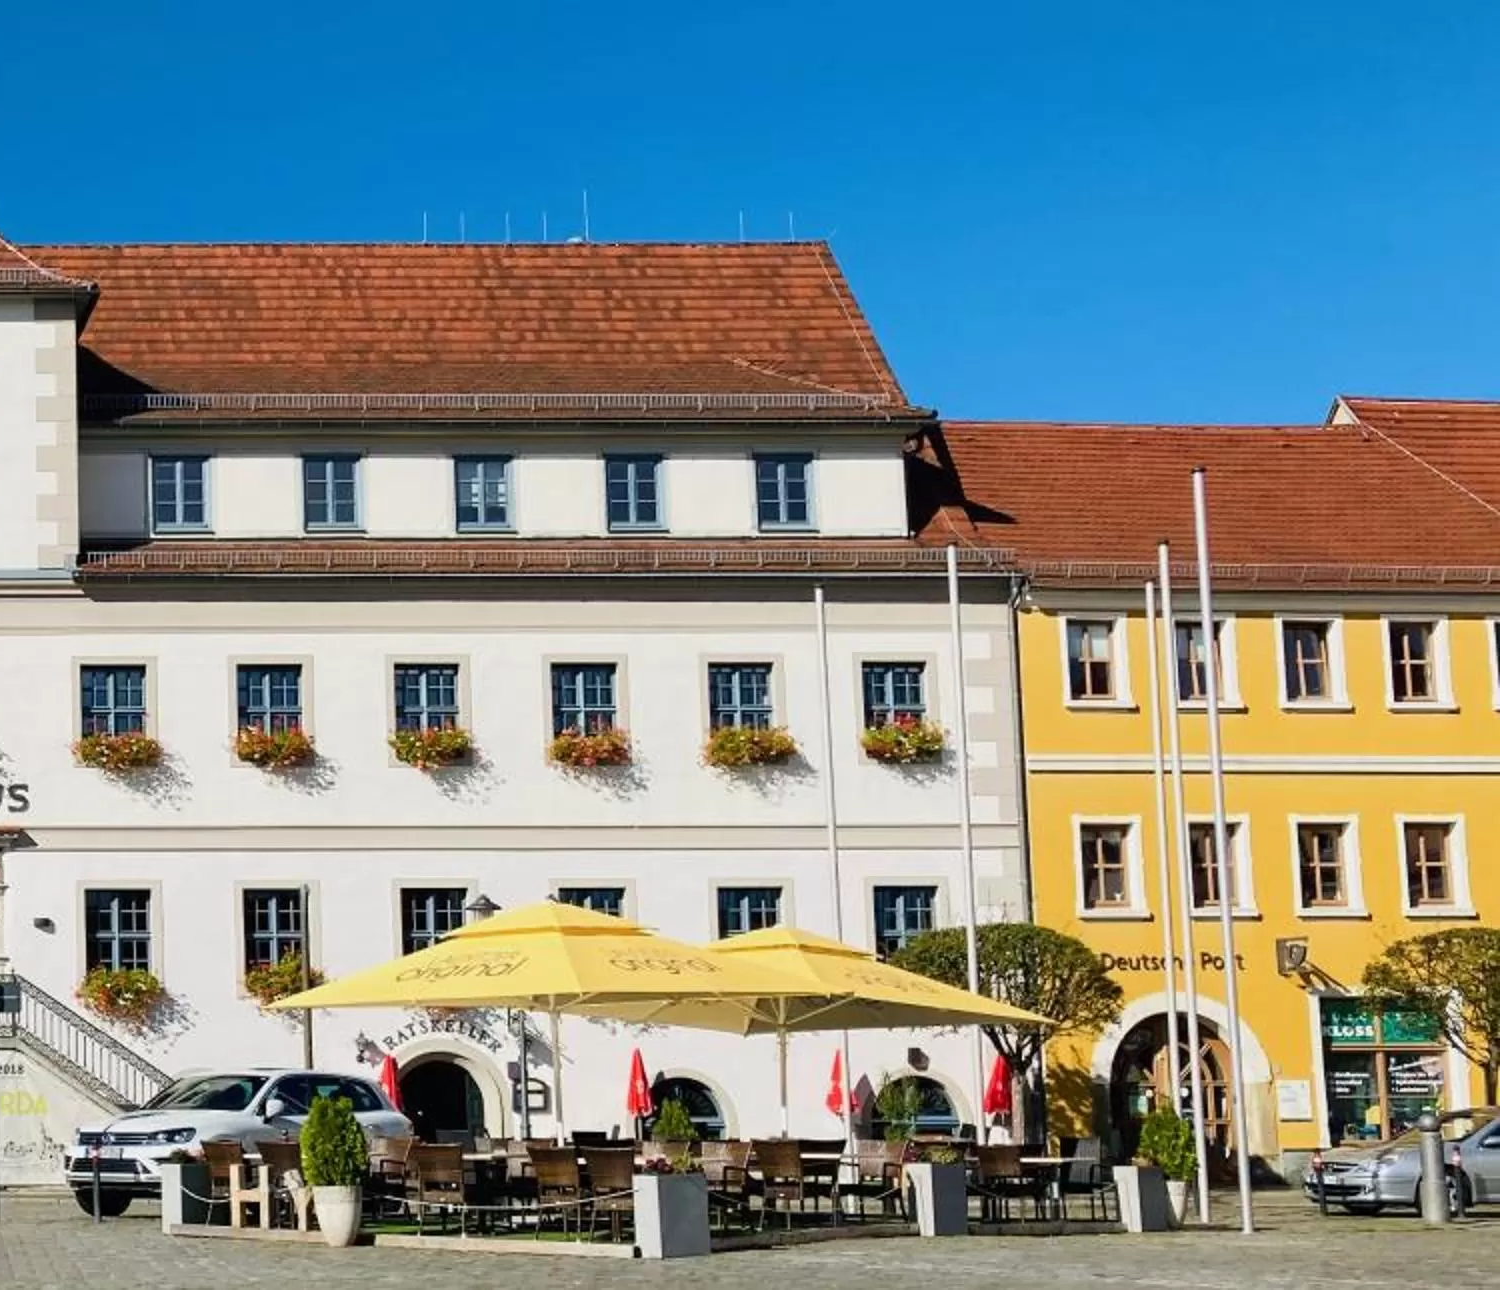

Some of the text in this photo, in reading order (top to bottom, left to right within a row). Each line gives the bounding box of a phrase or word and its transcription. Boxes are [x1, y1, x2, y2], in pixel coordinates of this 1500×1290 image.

[1100, 951, 1246, 971] Deutsch Pot
[383, 1019, 503, 1053] RATSKELLER
